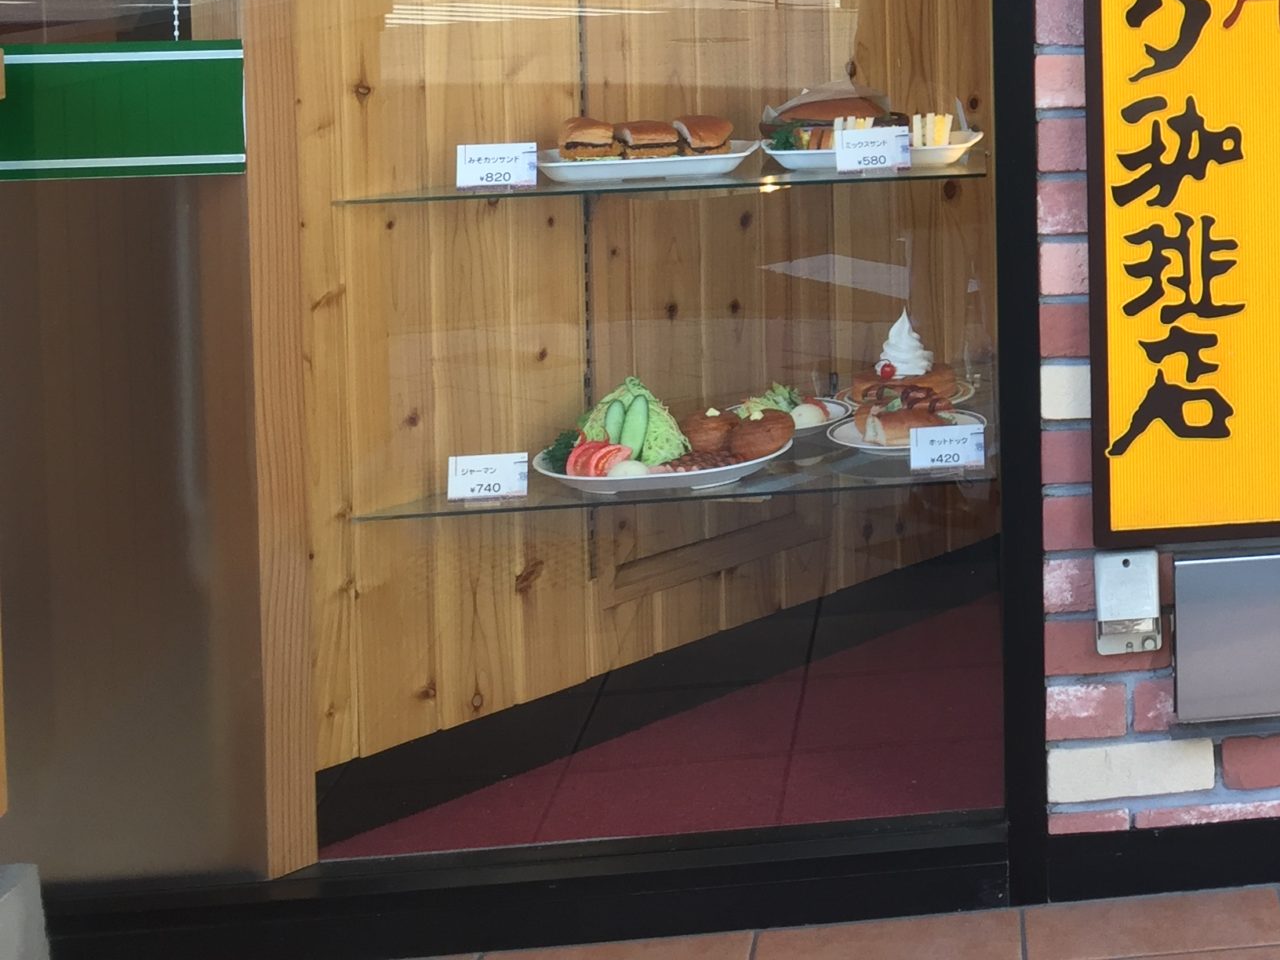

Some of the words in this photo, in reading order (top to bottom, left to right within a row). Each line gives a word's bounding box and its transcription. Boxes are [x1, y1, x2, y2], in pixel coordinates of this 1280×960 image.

[845, 140, 888, 149] ミックスサンド
[468, 156, 520, 164] みそカツサンド
[461, 467, 497, 476] ジャーマン
